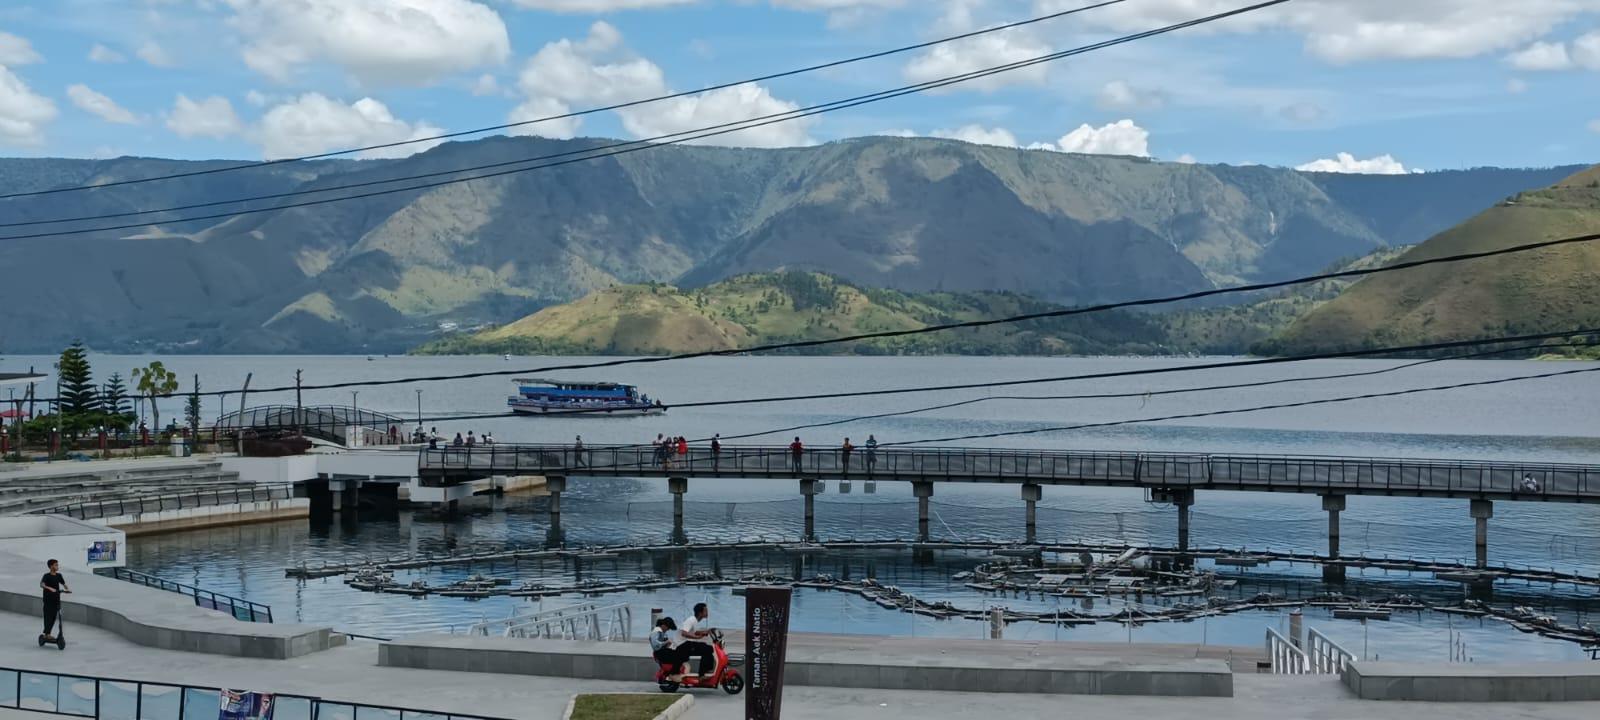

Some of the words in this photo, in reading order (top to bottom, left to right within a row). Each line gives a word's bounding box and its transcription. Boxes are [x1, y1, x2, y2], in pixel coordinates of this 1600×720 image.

[753, 607, 761, 634] Natio
[752, 635, 761, 656] Aek
[753, 657, 761, 689] Taman
